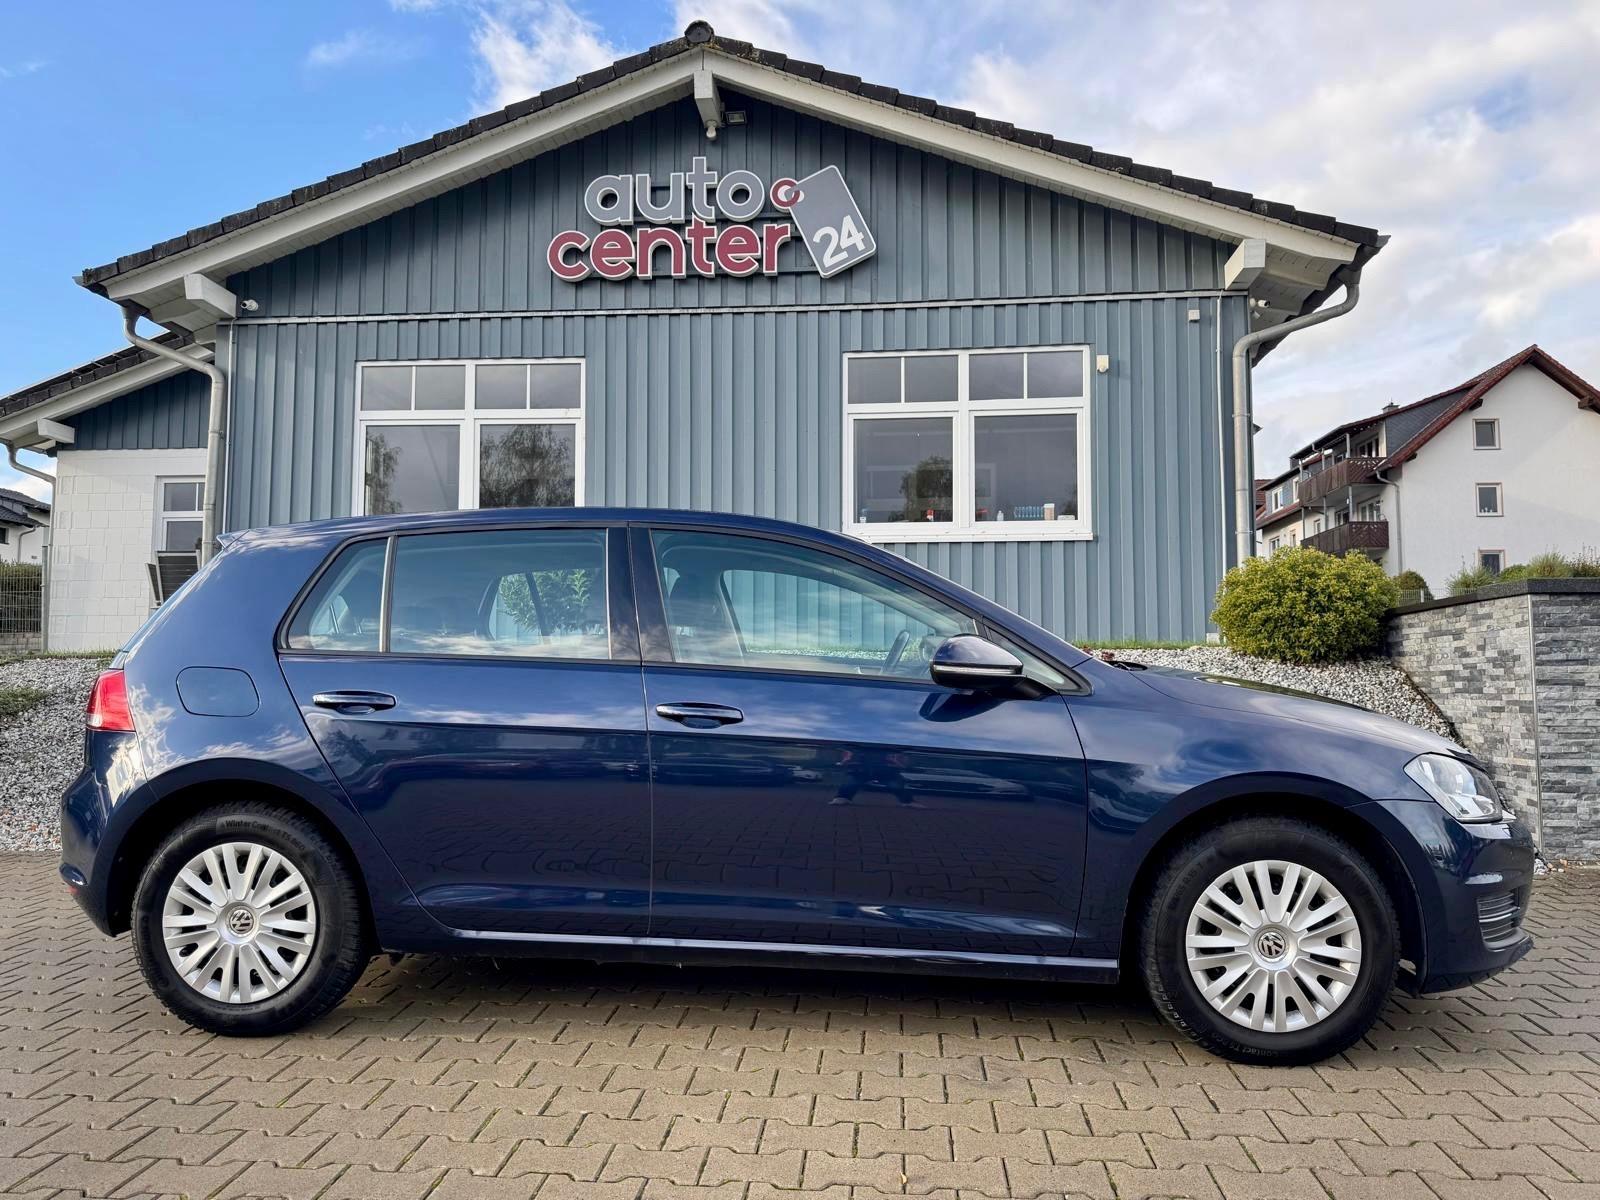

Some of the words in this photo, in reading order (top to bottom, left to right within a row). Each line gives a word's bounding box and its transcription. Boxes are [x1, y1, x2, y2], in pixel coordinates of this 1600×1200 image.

[584, 156, 765, 225] auto
[547, 212, 791, 282] center
[812, 214, 866, 268] 24
